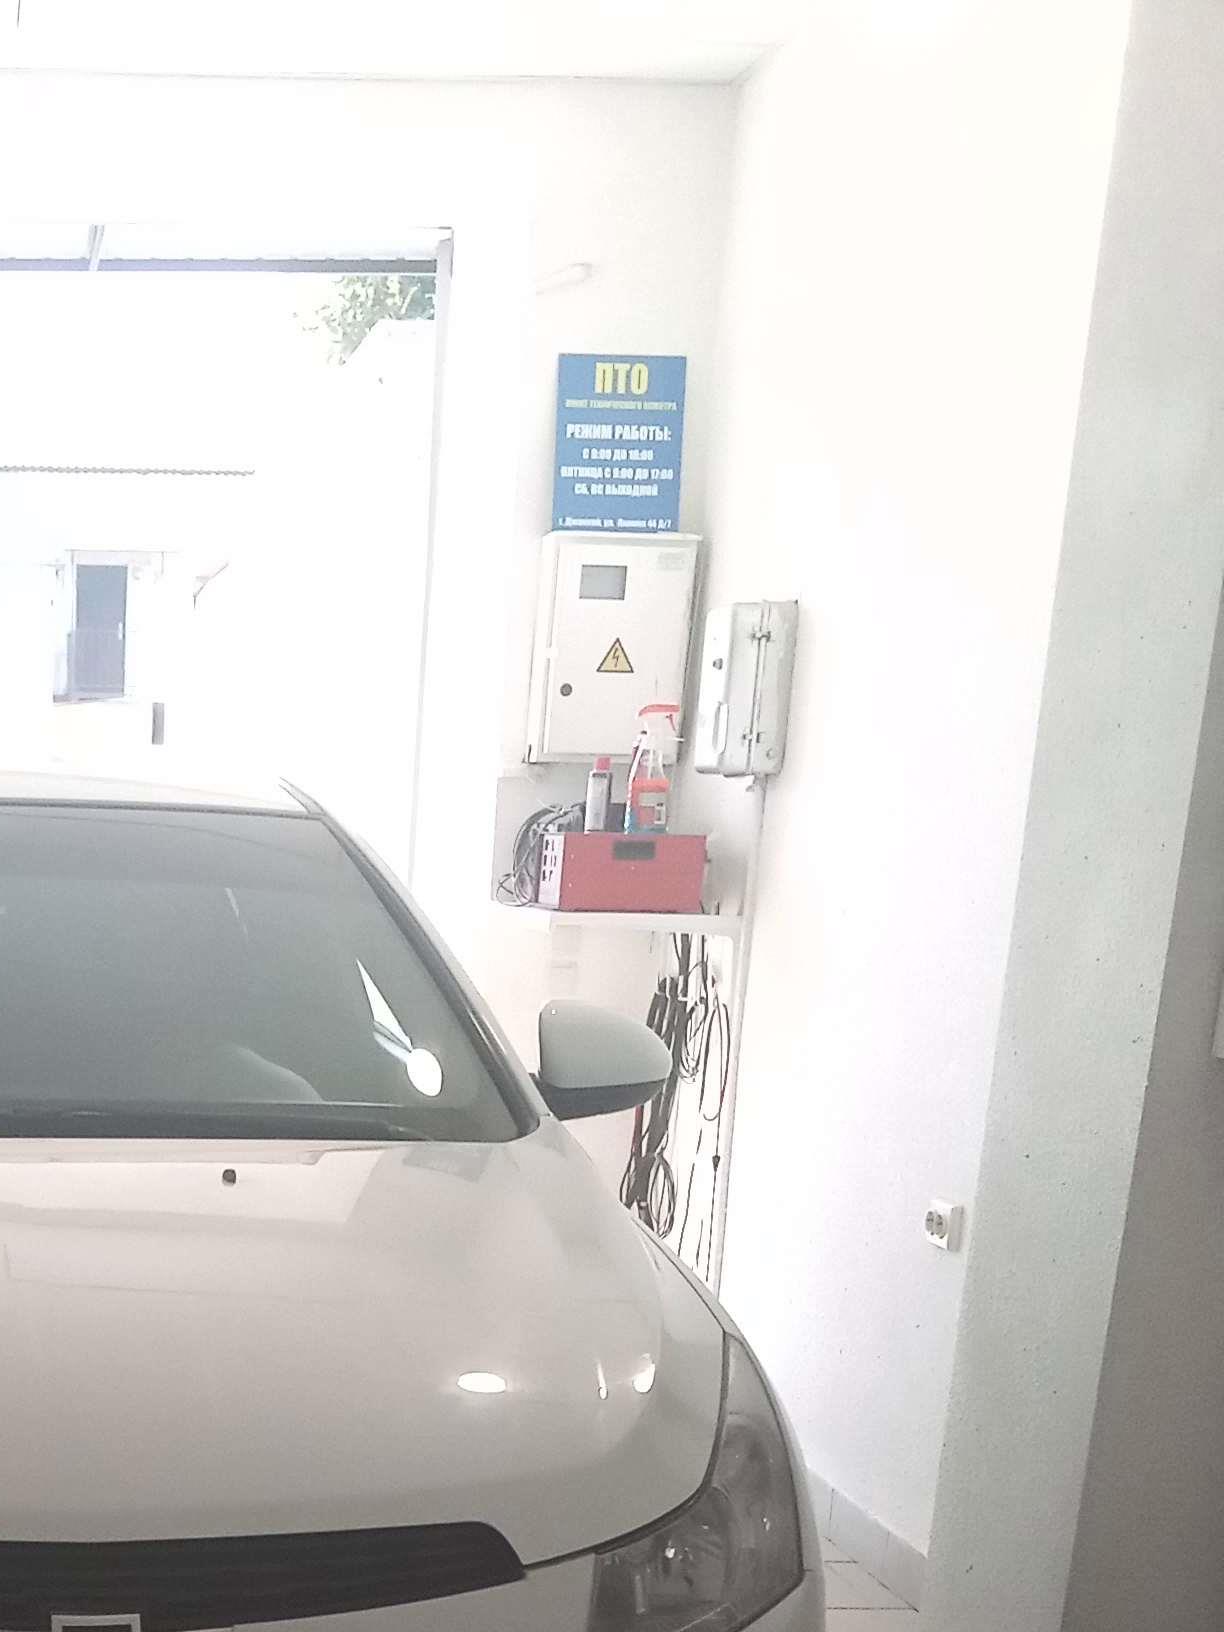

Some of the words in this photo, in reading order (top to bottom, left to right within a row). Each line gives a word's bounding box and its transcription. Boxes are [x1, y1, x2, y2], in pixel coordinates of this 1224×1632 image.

[594, 361, 649, 395] ПТО
[565, 422, 613, 440] РЕЖИМ
[614, 424, 672, 441] РАБОТЫ:
